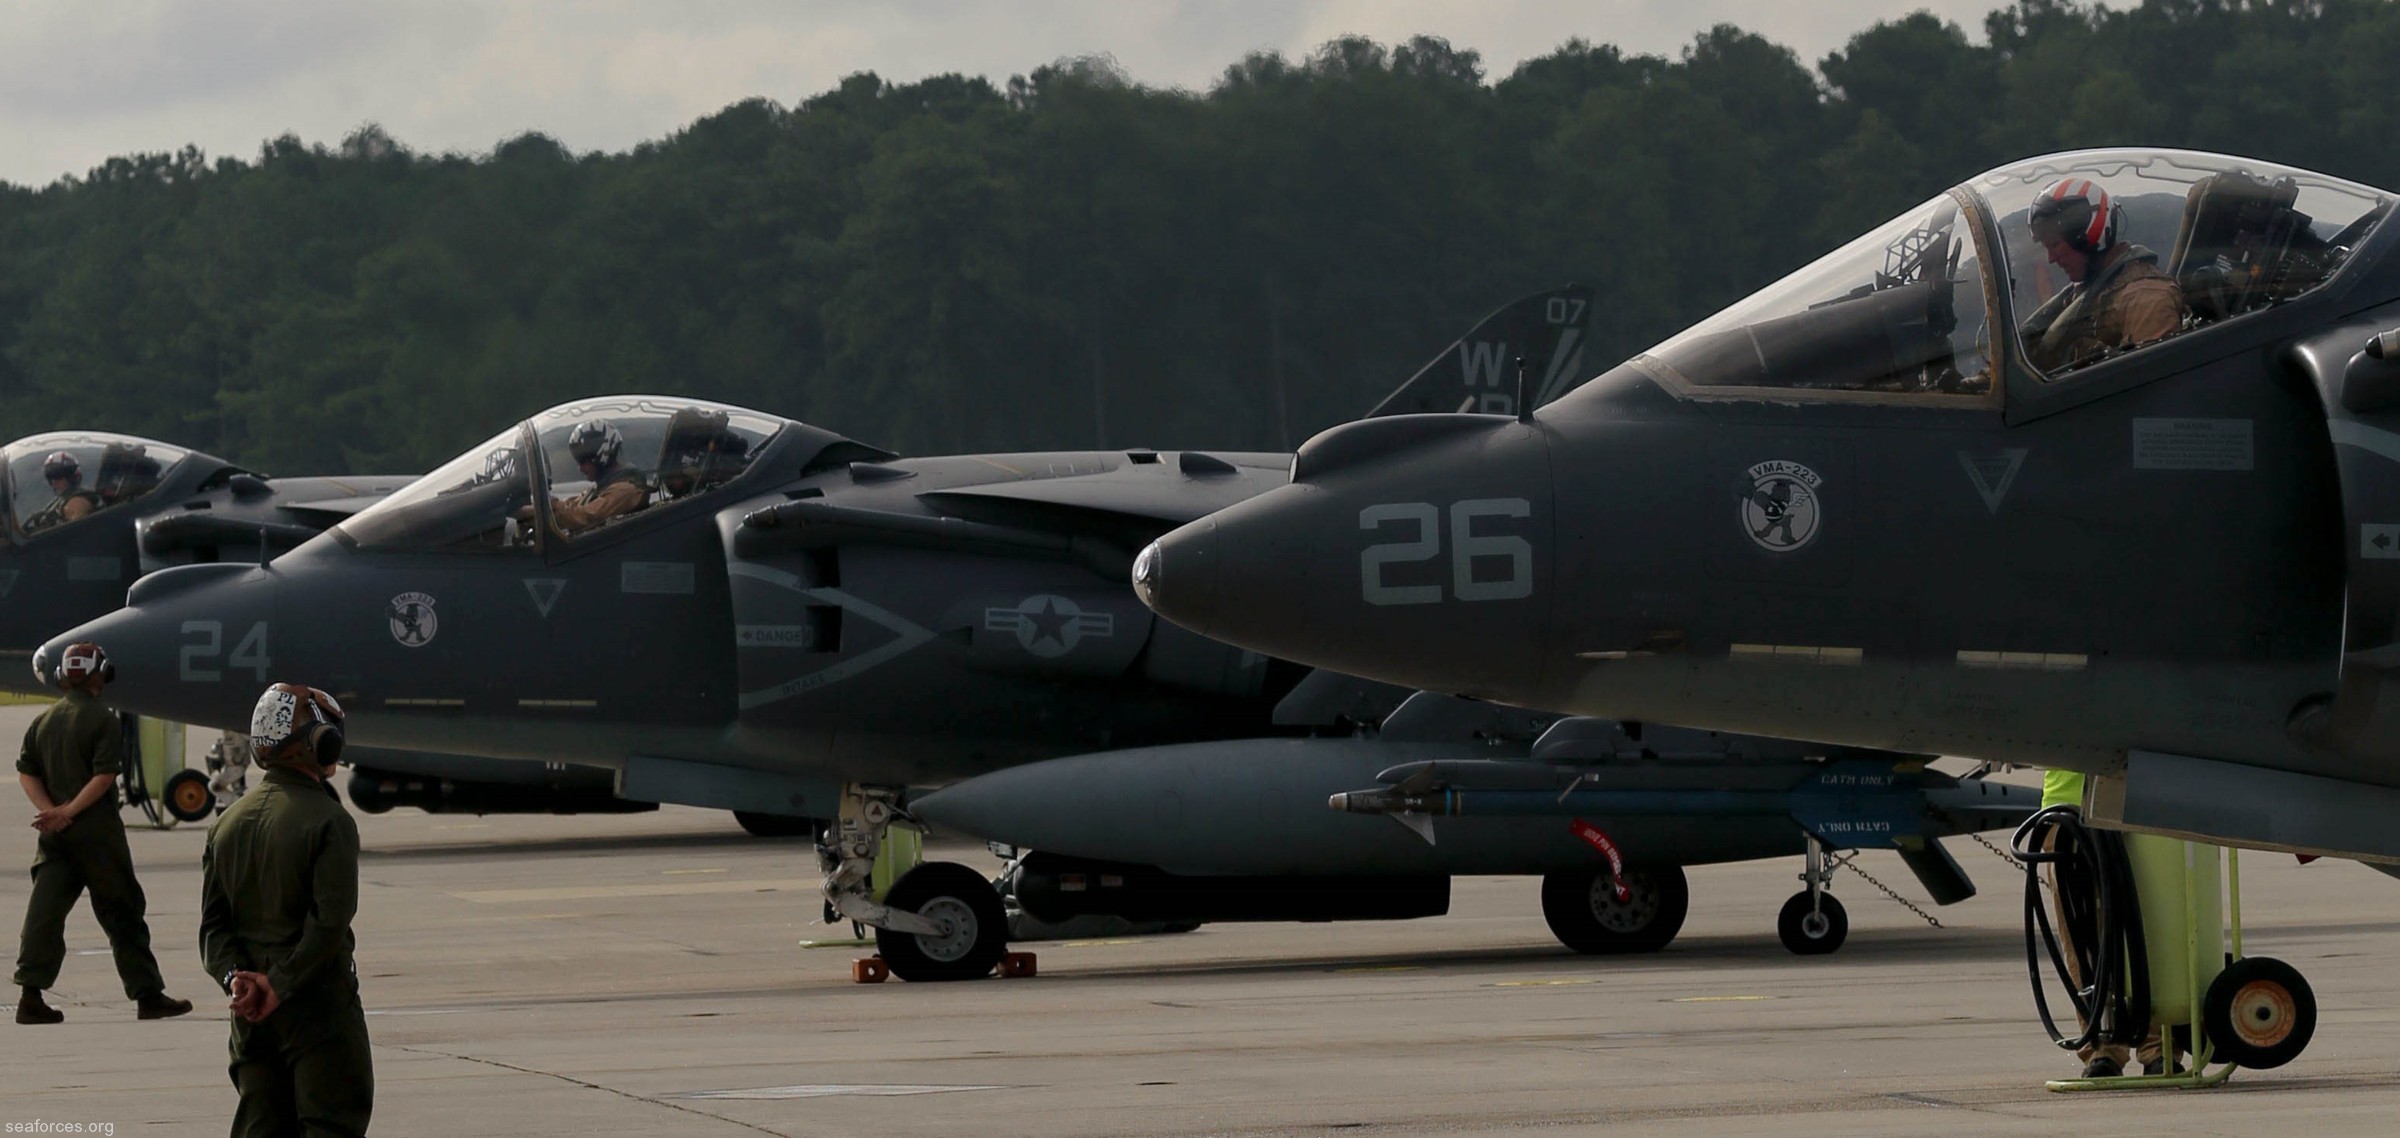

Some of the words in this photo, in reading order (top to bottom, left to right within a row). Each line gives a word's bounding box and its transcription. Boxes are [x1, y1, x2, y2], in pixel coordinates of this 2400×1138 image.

[1547, 298, 1586, 324] 07
[1459, 342, 1506, 387] W
[1753, 462, 1817, 484] VMA-223
[1359, 498, 1533, 606] 26
[180, 620, 271, 682] 24
[1821, 774, 1856, 785] CATM
[1860, 775, 1894, 786] ONLY
[1818, 821, 1851, 833] ONLY
[1855, 821, 1890, 832] CATM
